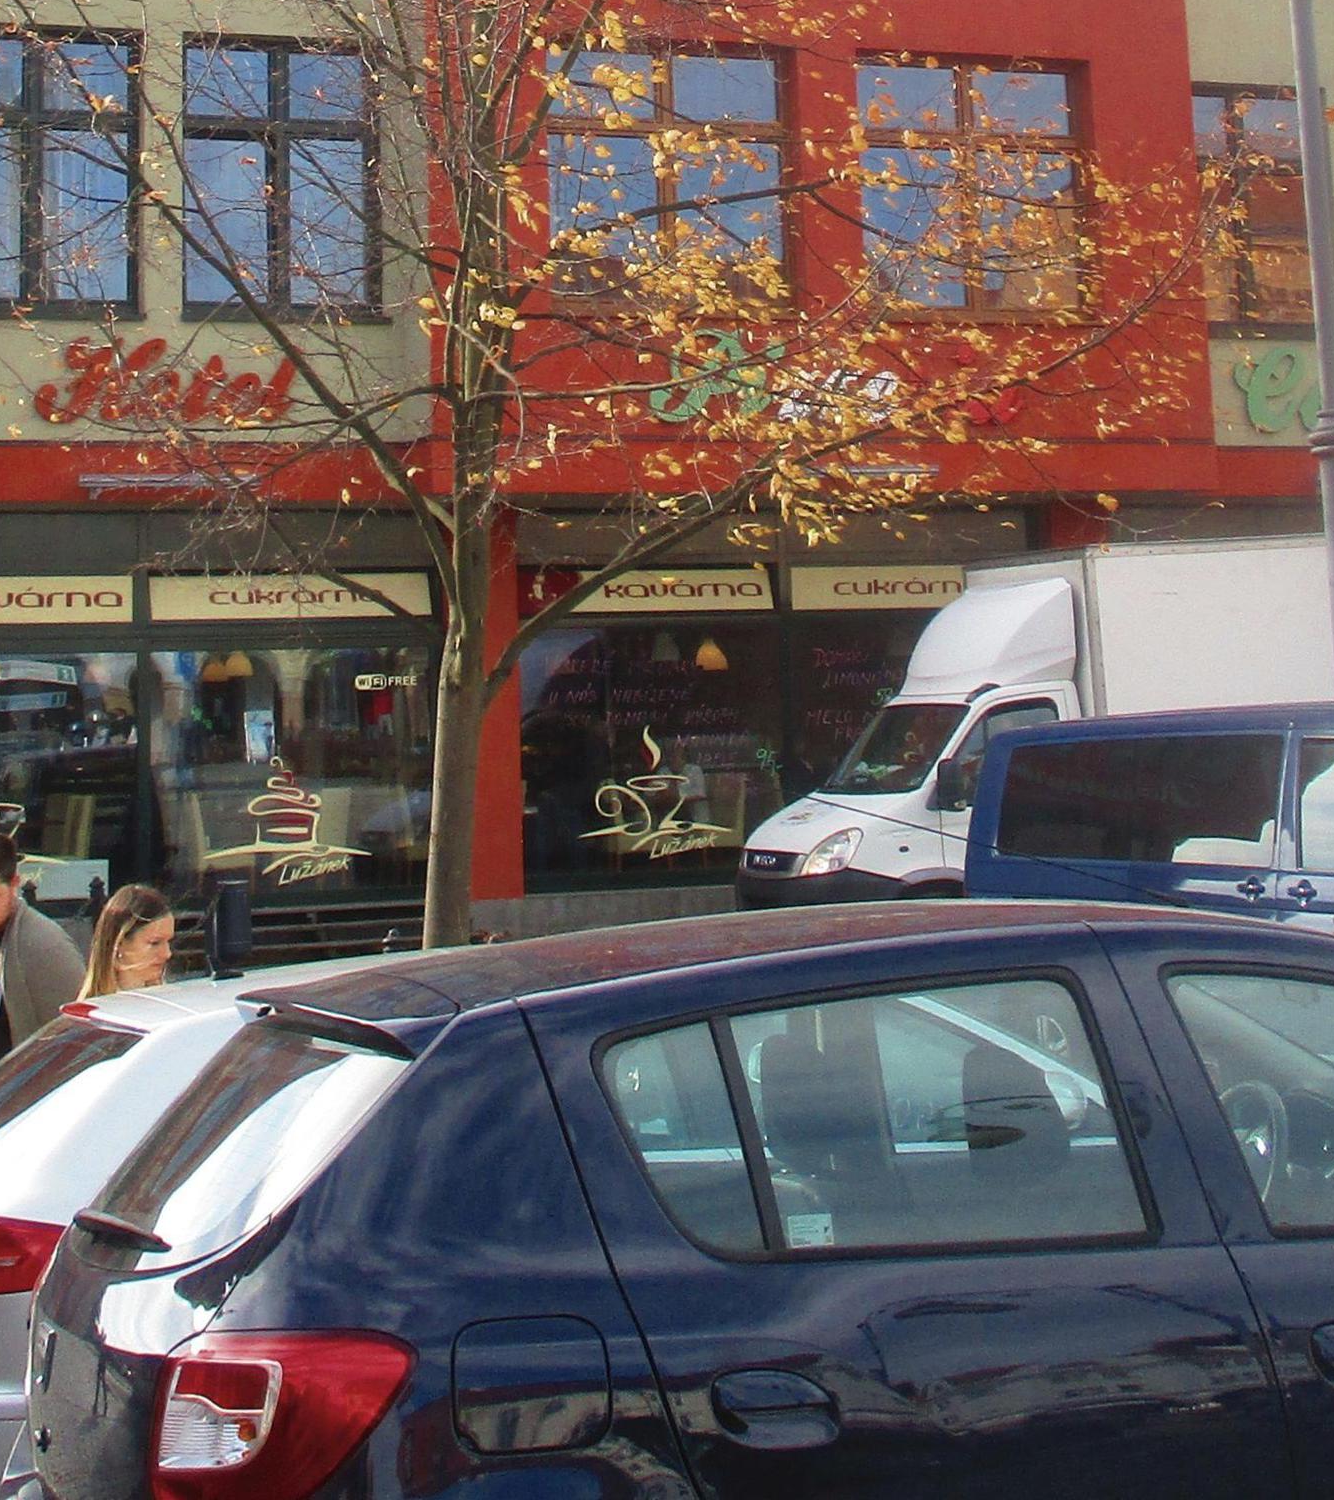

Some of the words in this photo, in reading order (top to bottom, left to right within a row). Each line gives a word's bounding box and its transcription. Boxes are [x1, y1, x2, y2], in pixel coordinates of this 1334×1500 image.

[833, 576, 963, 596] cukrárn
[388, 675, 417, 687] FREE
[277, 854, 352, 886] Lužánek
